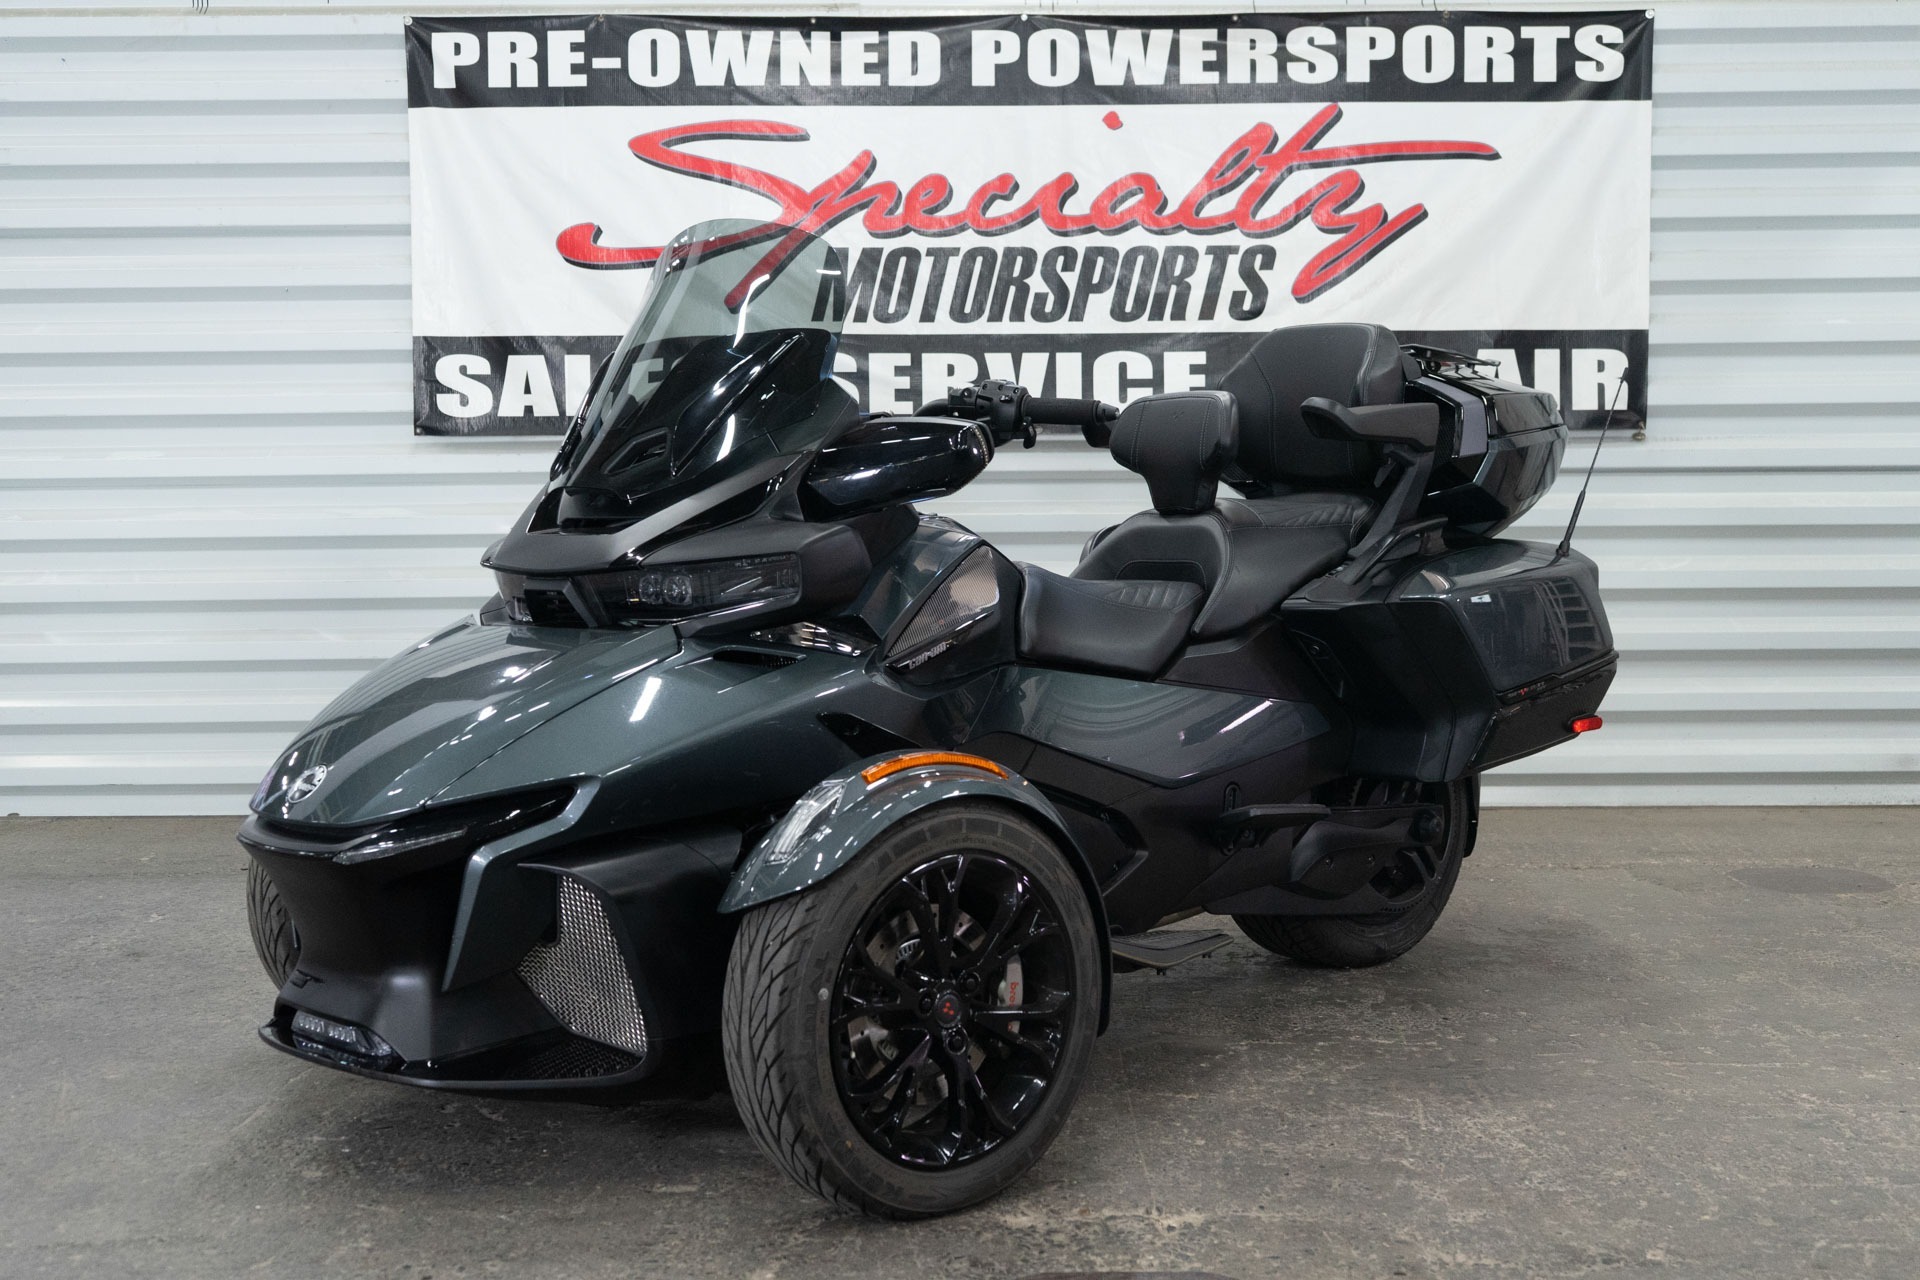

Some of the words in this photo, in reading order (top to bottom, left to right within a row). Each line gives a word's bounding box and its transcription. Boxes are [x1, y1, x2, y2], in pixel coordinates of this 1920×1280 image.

[430, 28, 942, 89] PRE-OWNED
[971, 23, 1625, 88] POWERSPORTS
[556, 102, 1502, 314] Specialty
[811, 244, 1277, 324] MOTORSPORTS
[434, 353, 684, 419] SALE
